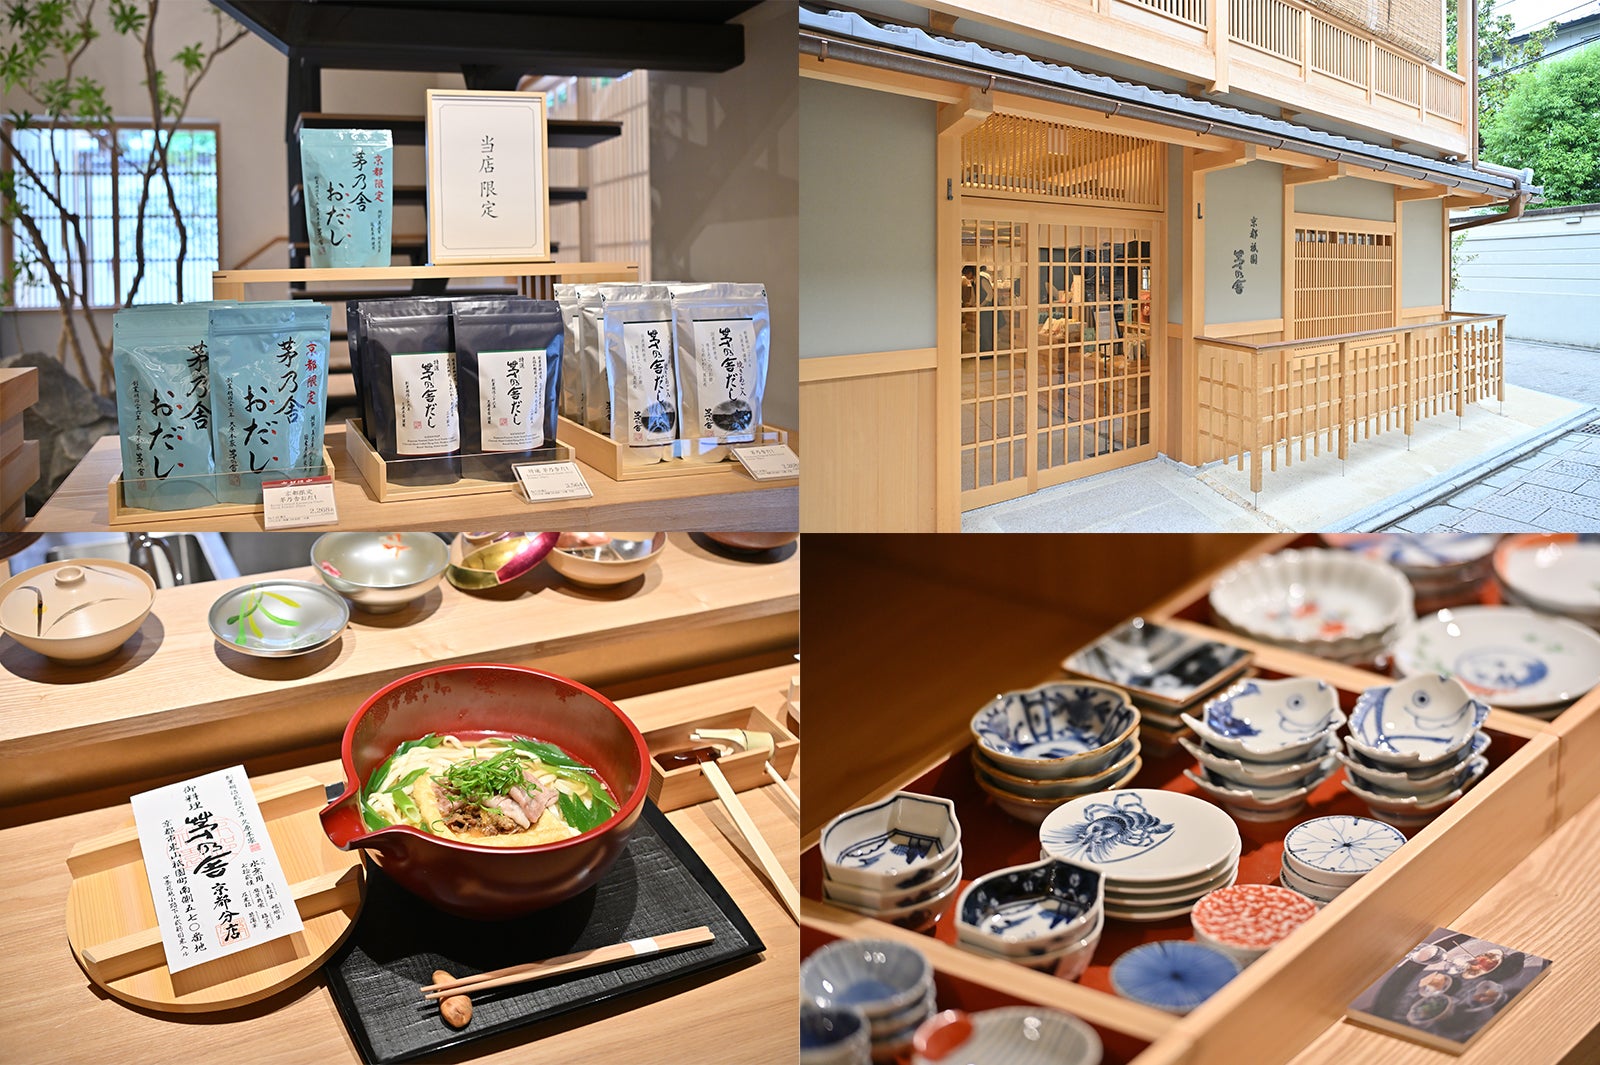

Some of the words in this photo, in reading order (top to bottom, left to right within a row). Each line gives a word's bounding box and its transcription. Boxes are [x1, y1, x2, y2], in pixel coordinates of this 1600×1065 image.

[349, 150, 372, 213] 茅乃舎
[372, 154, 385, 203] 京都限定
[478, 135, 498, 219] 当店限定
[326, 181, 352, 246] おだし
[180, 340, 211, 430] 茅乃舎
[273, 336, 305, 425] 茅乃舎
[305, 341, 318, 405] 京都限定
[420, 362, 438, 429] 茅乃舎だし
[506, 360, 523, 426] 茅乃舎だし
[647, 329, 665, 403] 茅乃舎だし
[718, 327, 738, 401] 茅乃舎だし
[148, 389, 185, 481] おだし
[243, 385, 278, 474] おだし
[183, 785, 203, 811] 御料理
[184, 811, 232, 879] 茅乃舎
[211, 883, 241, 942] 京都分店
